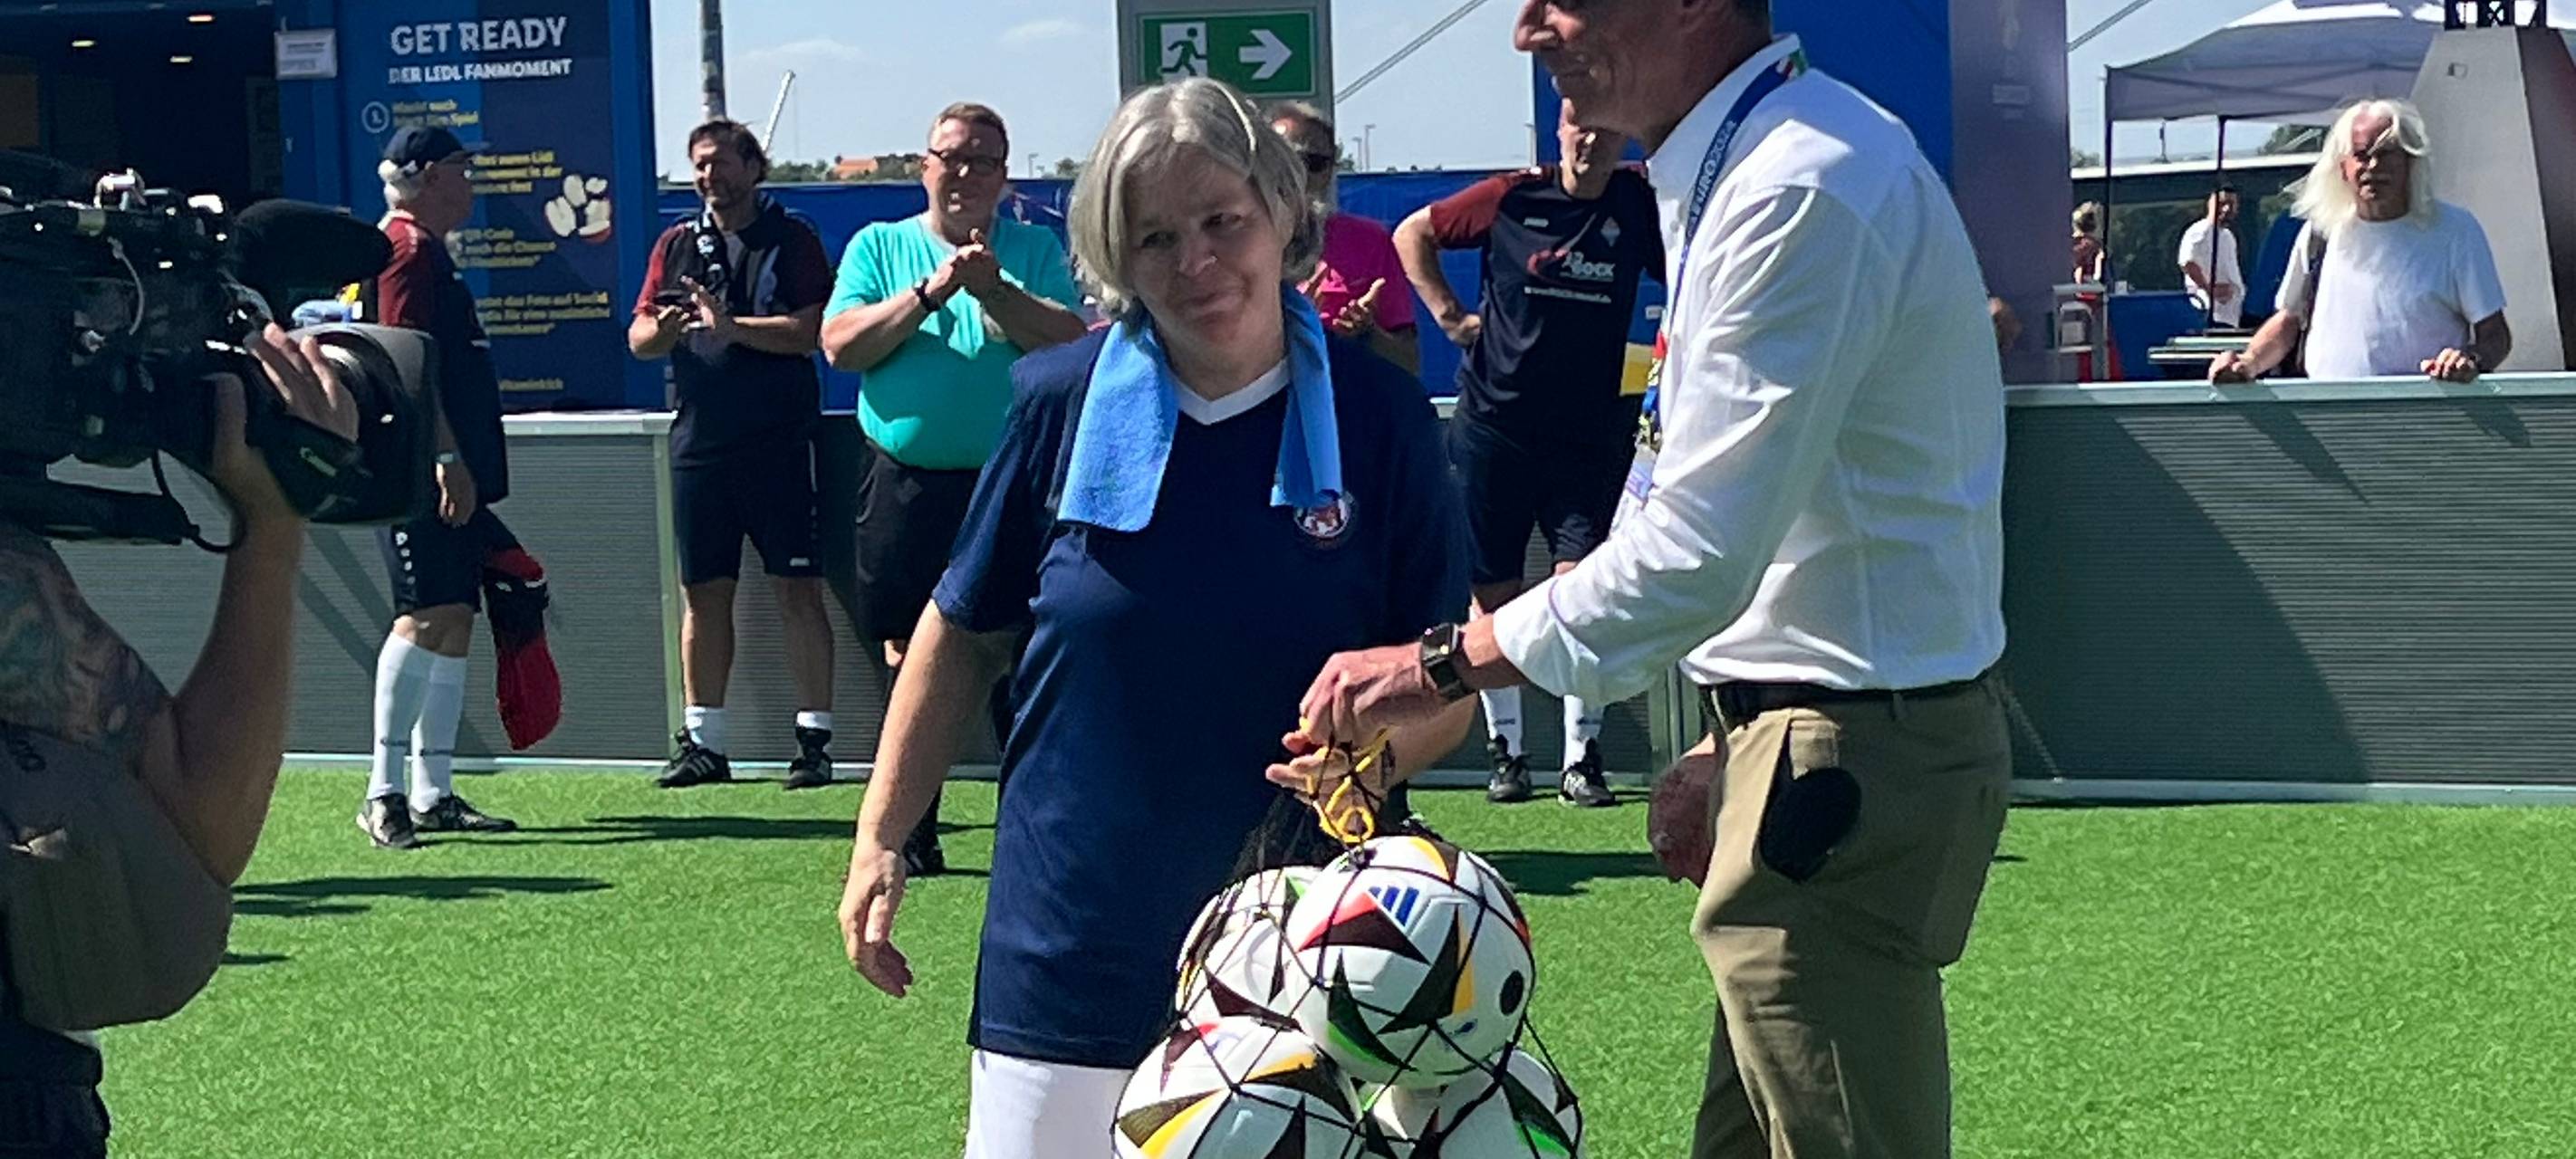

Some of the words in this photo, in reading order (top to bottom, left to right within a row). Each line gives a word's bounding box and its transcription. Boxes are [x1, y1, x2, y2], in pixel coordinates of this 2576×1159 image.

[390, 22, 451, 55] GET
[458, 16, 567, 52] READY
[389, 66, 422, 84] DER
[465, 59, 572, 81] FANMOMENT
